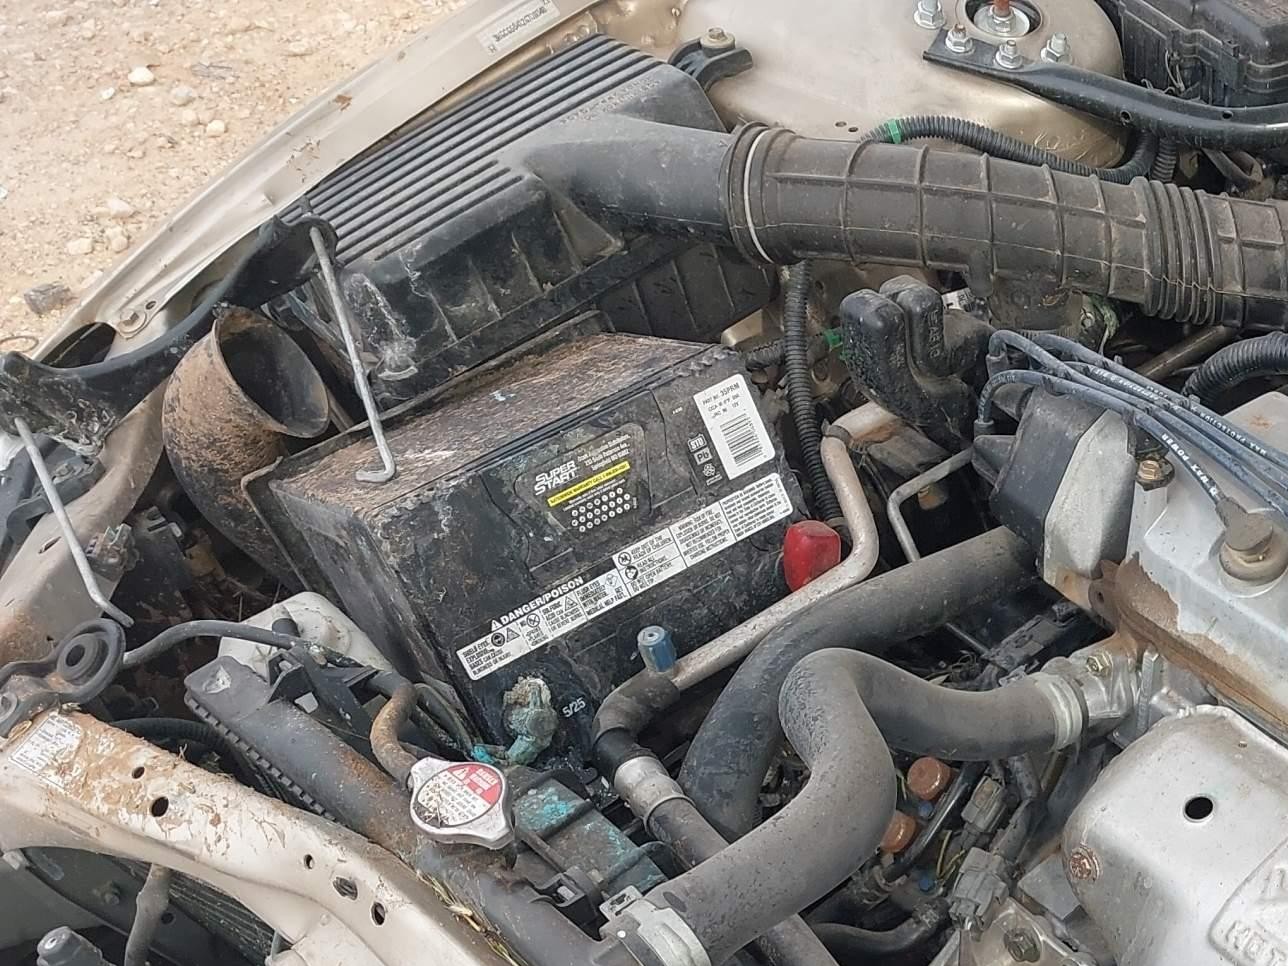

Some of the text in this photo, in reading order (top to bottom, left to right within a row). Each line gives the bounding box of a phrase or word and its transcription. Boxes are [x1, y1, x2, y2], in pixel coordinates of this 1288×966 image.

[697, 450, 710, 462] Pb
[1161, 432, 1190, 462] POWER
[533, 470, 576, 496] START
[535, 460, 576, 485] SUPER
[1191, 462, 1210, 484] MAX
[500, 576, 584, 620] DANGER/POISON
[562, 697, 586, 718] 5/25
